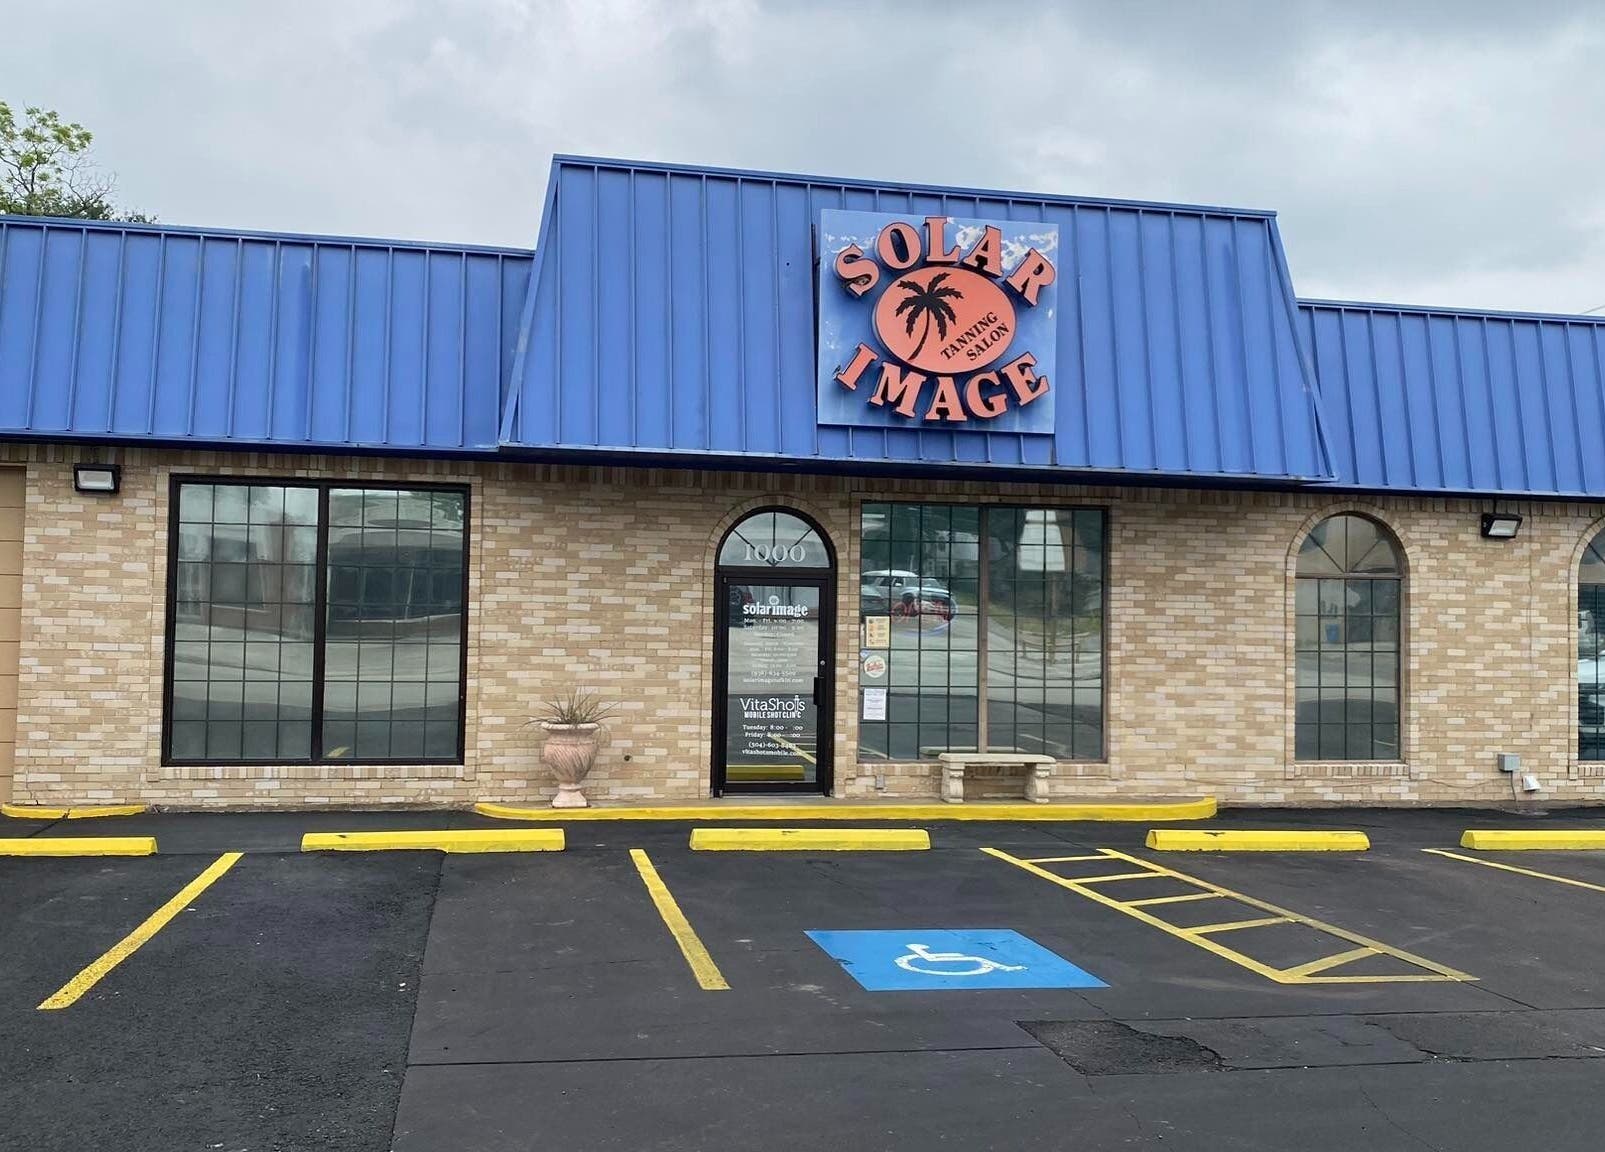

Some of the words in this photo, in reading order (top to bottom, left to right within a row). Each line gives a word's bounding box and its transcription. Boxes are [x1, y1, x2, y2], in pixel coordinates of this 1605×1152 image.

[834, 216, 1056, 307] SOLAR
[940, 311, 998, 361] TANNING
[966, 323, 1010, 361] SALON
[835, 343, 1050, 422] IMAGE
[744, 543, 806, 562] 1000
[740, 695, 805, 712] VitaShots
